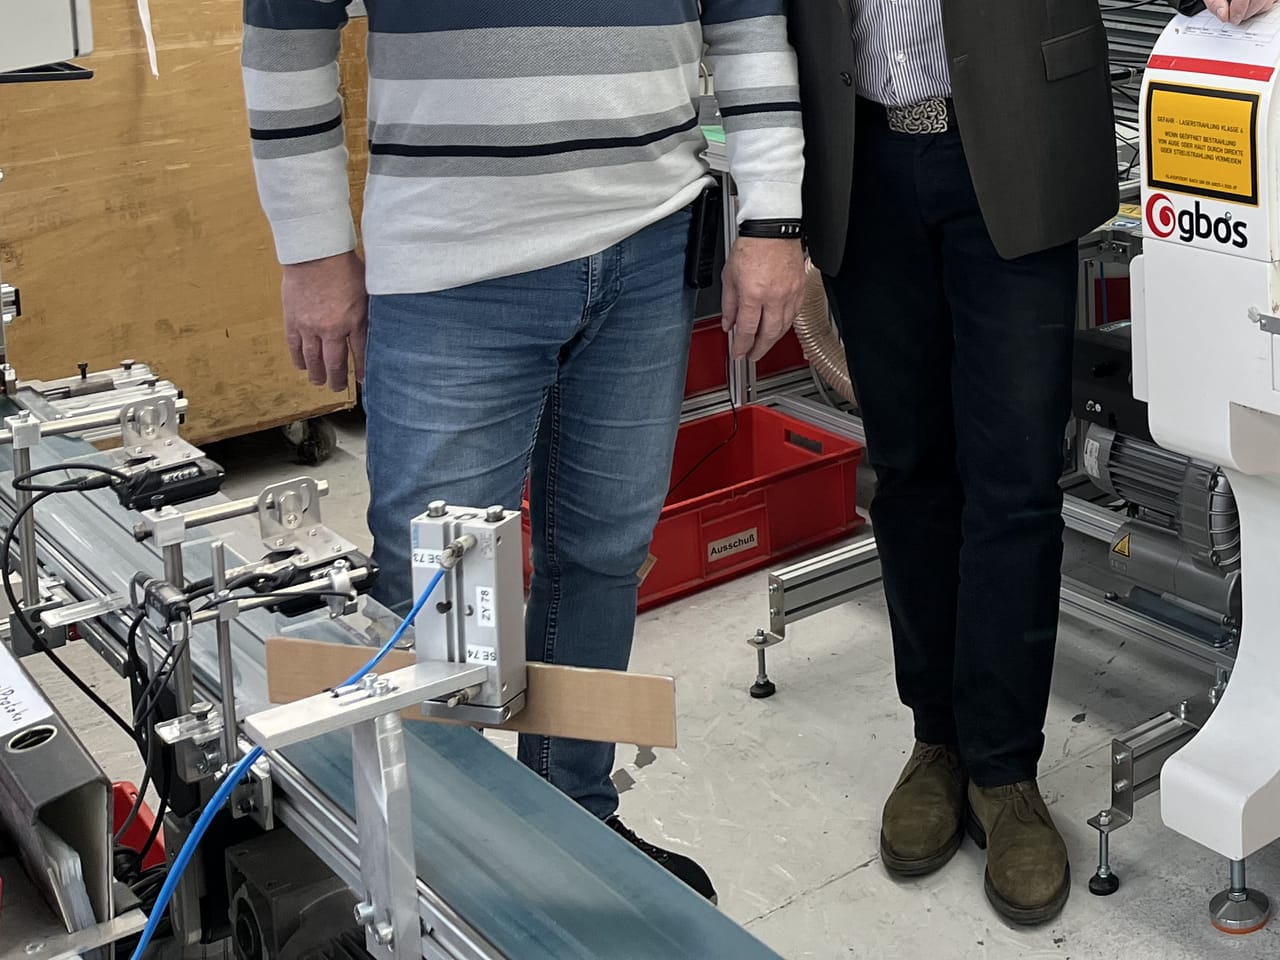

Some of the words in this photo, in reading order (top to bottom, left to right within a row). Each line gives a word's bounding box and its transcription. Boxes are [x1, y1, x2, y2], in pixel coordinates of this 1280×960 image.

[1178, 200, 1248, 248] gbos
[711, 534, 755, 556] Ausschuß
[480, 590, 489, 602] 78
[482, 606, 491, 621] ZY
[467, 650, 479, 659] 74
[483, 651, 497, 661] SE
